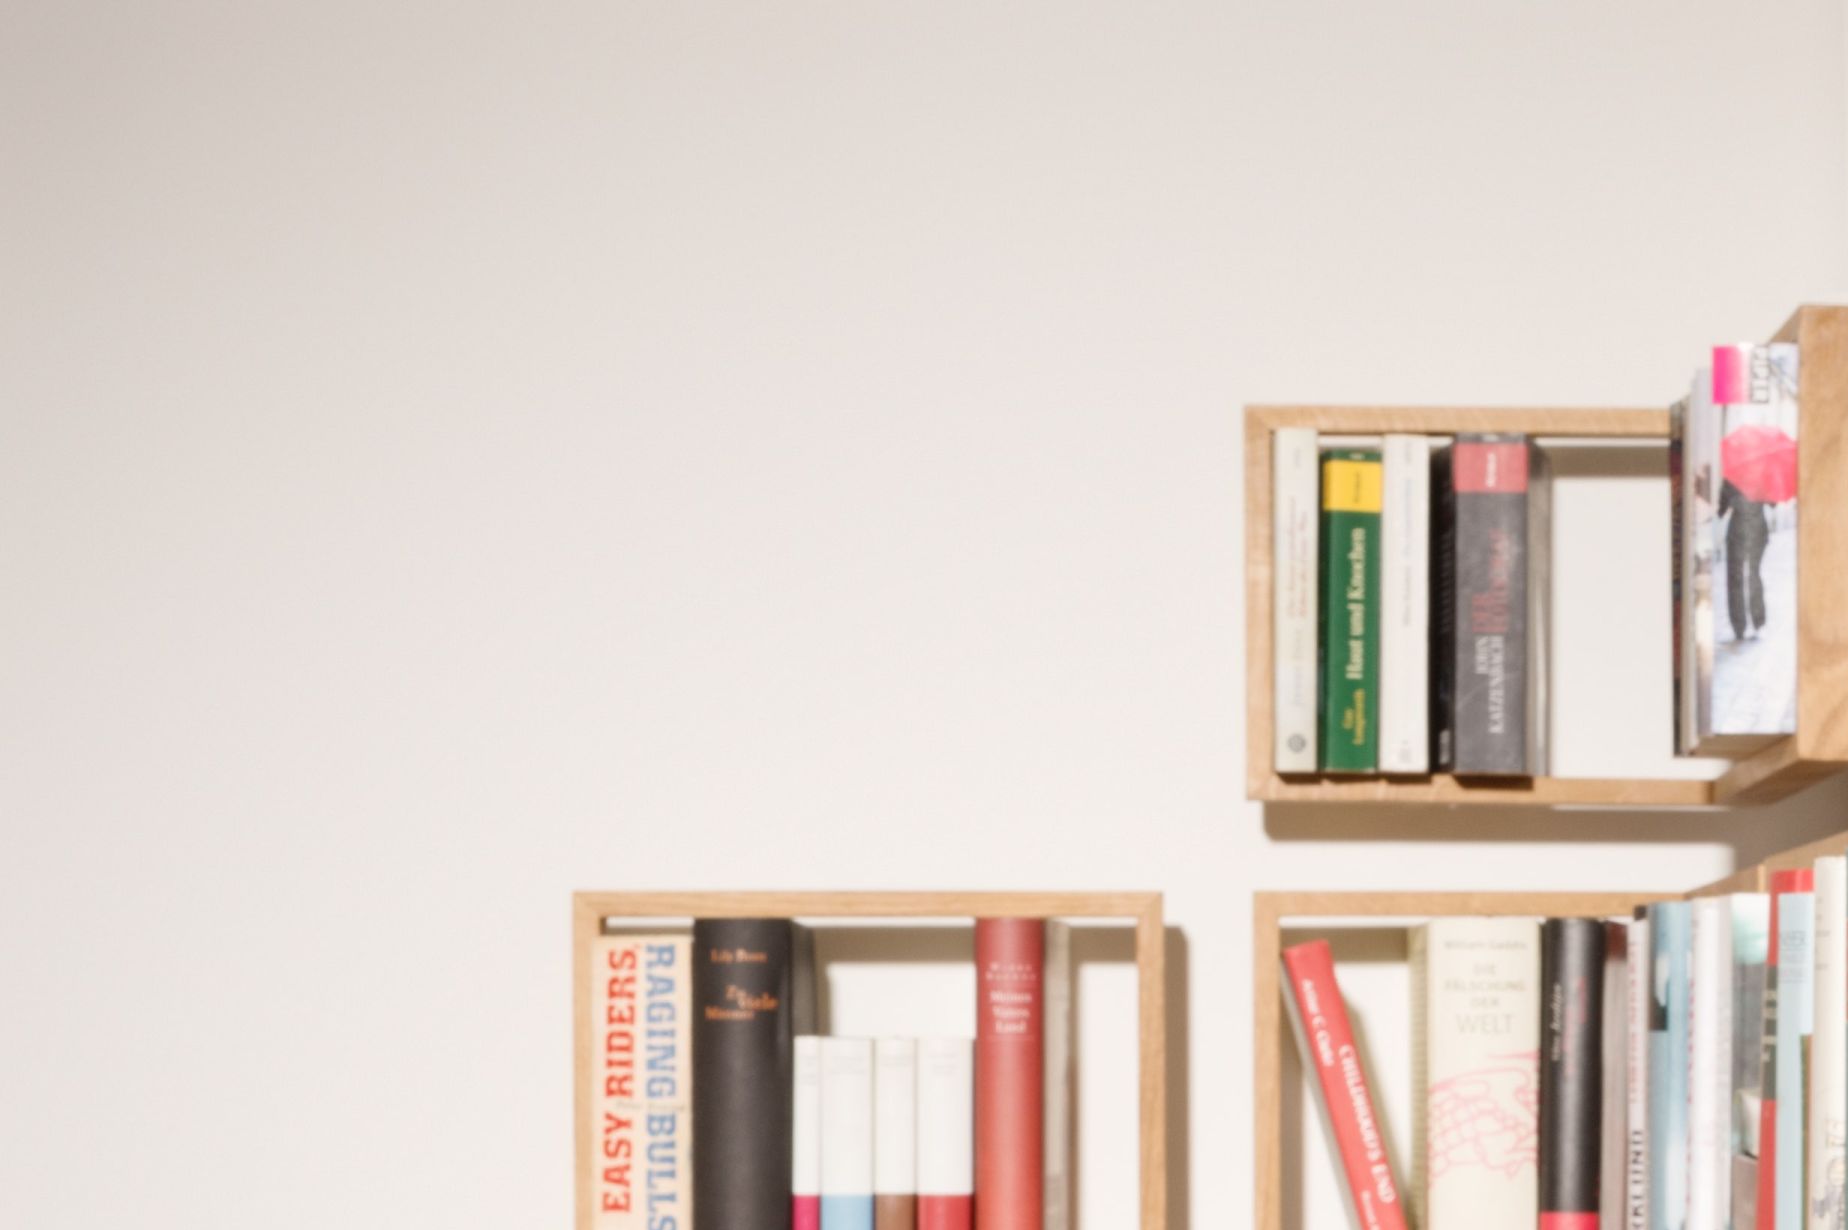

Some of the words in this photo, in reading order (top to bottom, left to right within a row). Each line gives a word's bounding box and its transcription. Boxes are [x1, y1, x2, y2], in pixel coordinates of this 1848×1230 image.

[1346, 528, 1367, 600] Knochen
[1346, 603, 1366, 636] und
[1345, 640, 1365, 679] Haut
[605, 948, 638, 1098] RIDERS
[645, 943, 676, 1099] RAGING
[1455, 1012, 1514, 1035] WELT
[602, 1112, 632, 1213] EASY
